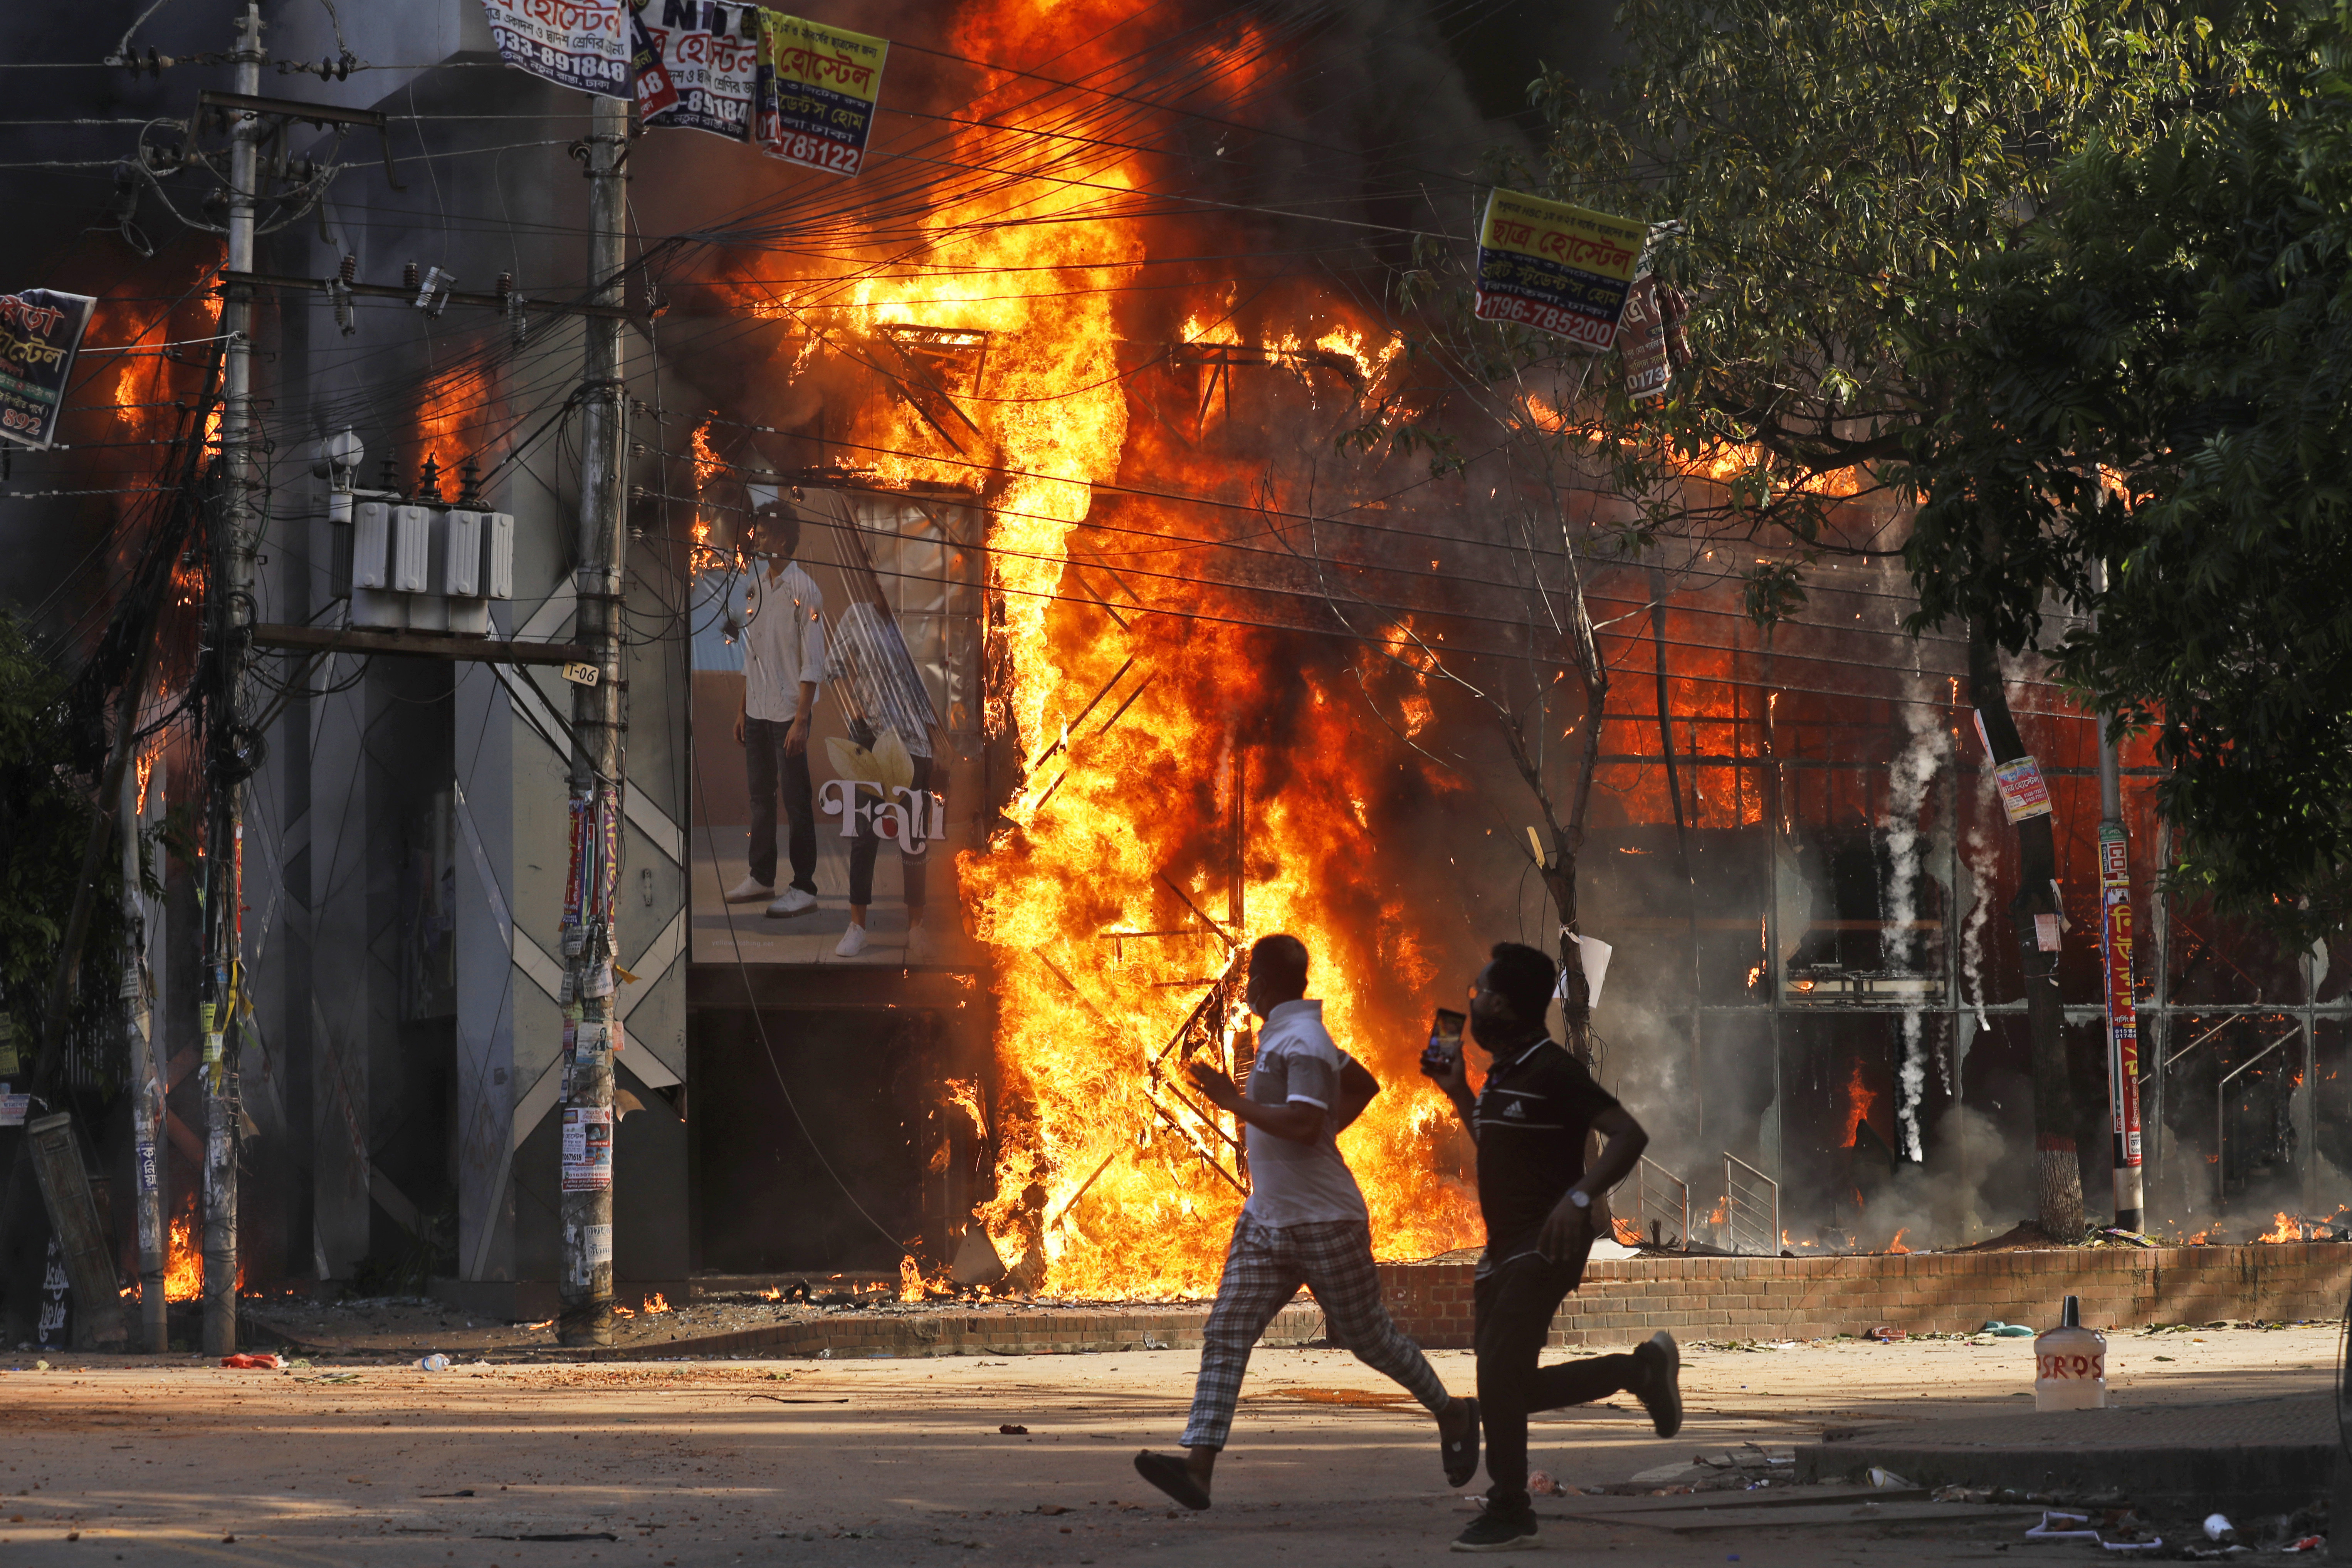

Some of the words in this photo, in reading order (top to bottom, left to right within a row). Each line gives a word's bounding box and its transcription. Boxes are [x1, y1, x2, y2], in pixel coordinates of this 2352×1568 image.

[504, 14, 534, 35] একাদশ
[536, 27, 543, 38] ও
[546, 29, 569, 47] দ্বাদশ
[573, 33, 604, 50] শ্রেণির
[606, 39, 625, 56] জন্য
[862, 45, 879, 59] জন্য
[530, 60, 553, 76] নতুন
[585, 79, 610, 89] ঢাকা
[781, 47, 875, 95] হোস্টেল
[674, 115, 700, 125] নতুন
[831, 108, 866, 131] হোম
[1522, 206, 1541, 219] HSC
[1492, 218, 1537, 248] ছাত্র
[1539, 231, 1635, 275] হোস্টেল
[1480, 260, 1514, 281] ব্রাইট
[1588, 286, 1623, 308] হোম
[1568, 301, 1613, 319] ঢাকা
[1628, 355, 1650, 372] খলিল
[3, 409, 42, 436] 892
[569, 663, 596, 682] T-06
[2015, 776, 2040, 790] হোস্টেল
[818, 779, 946, 855] Fall
[2114, 1014, 2129, 1023] নার্সিং
